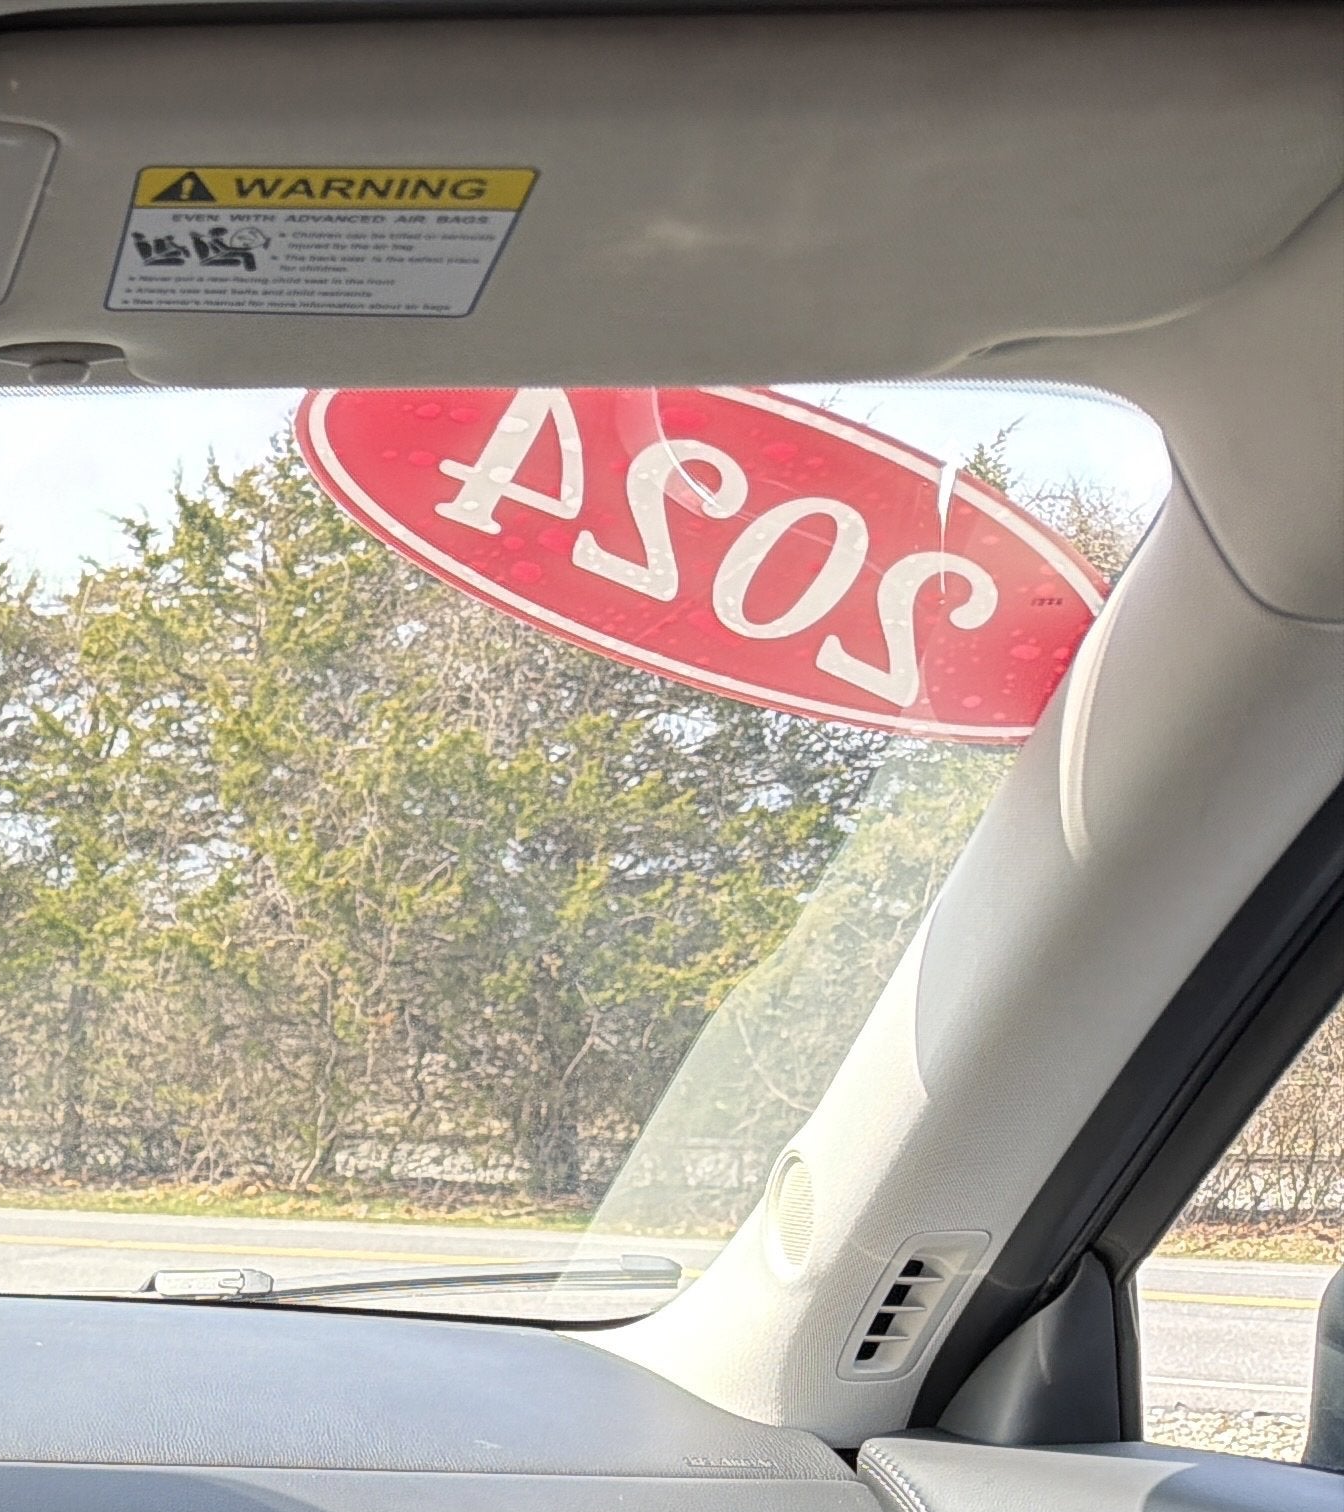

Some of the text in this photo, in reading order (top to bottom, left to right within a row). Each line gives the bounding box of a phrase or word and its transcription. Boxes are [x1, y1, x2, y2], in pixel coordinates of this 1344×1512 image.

[233, 177, 489, 200] WARNING
[171, 214, 489, 225] EVEN WITH ADVANCED AIR BAGS
